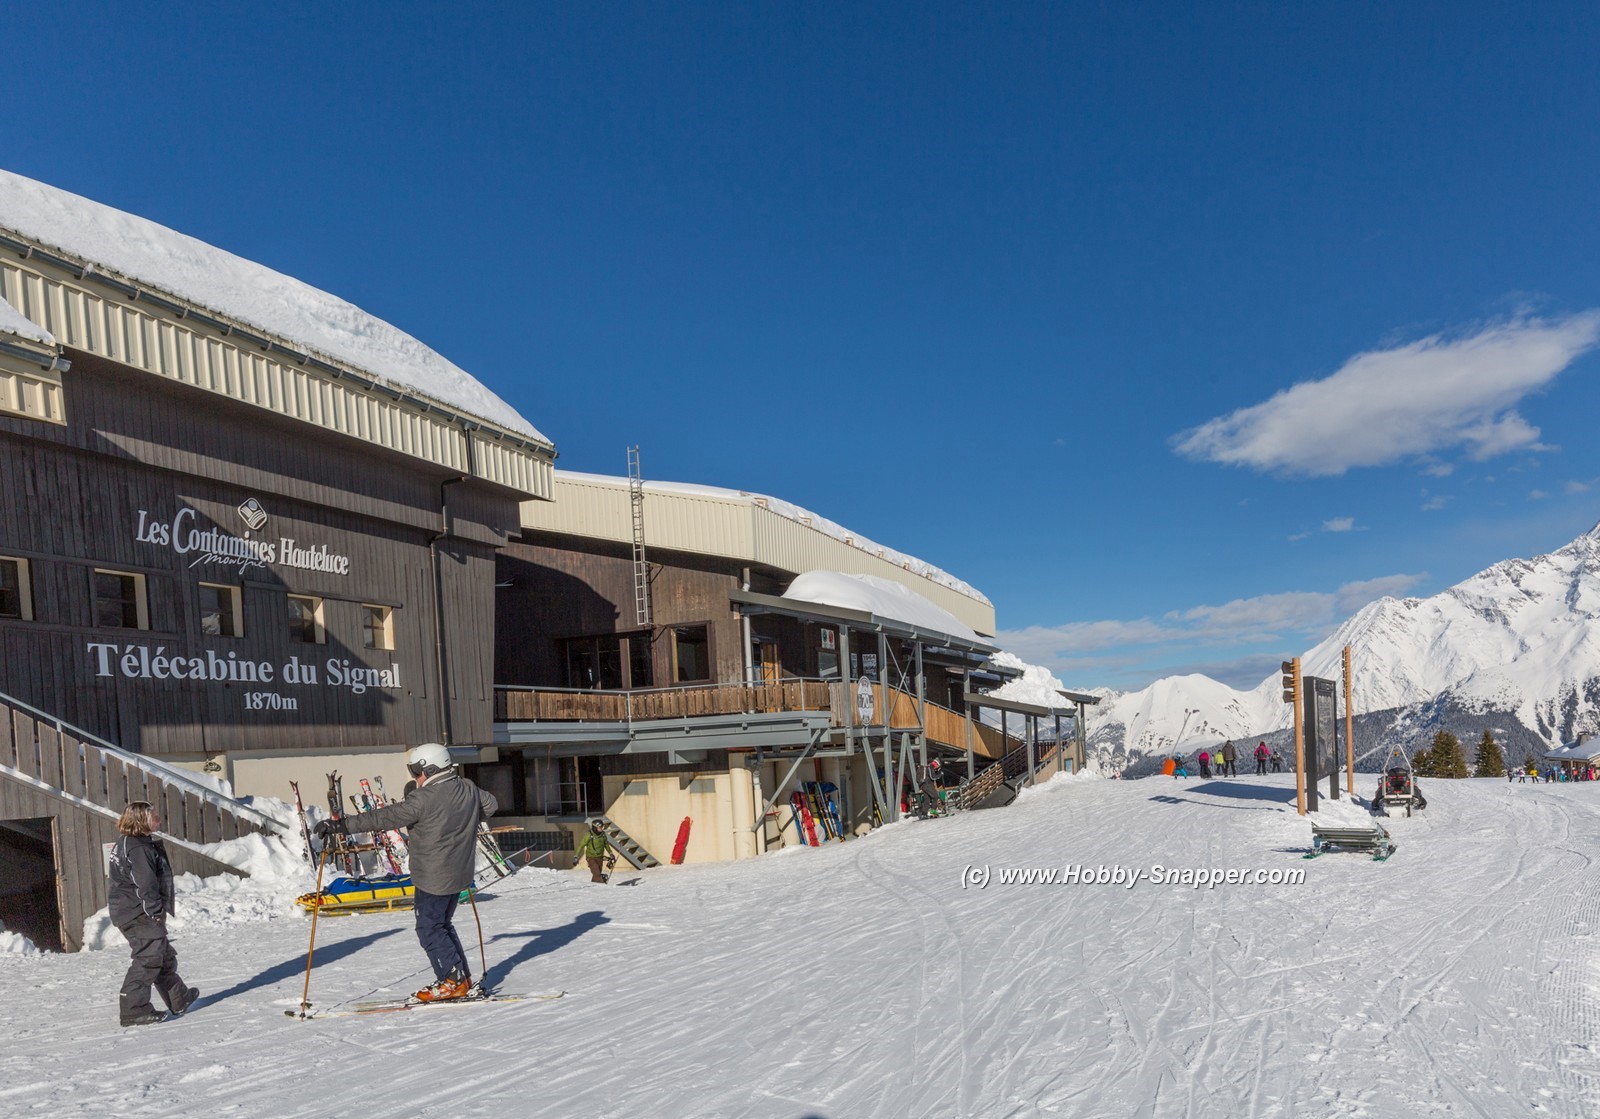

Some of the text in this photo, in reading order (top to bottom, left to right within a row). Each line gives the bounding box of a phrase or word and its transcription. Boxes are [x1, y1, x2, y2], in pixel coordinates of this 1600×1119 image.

[136, 507, 349, 575] Les Contamines Hauteluce
[87, 643, 402, 694] Télécabine du Signal
[243, 692, 298, 711] 1870m
